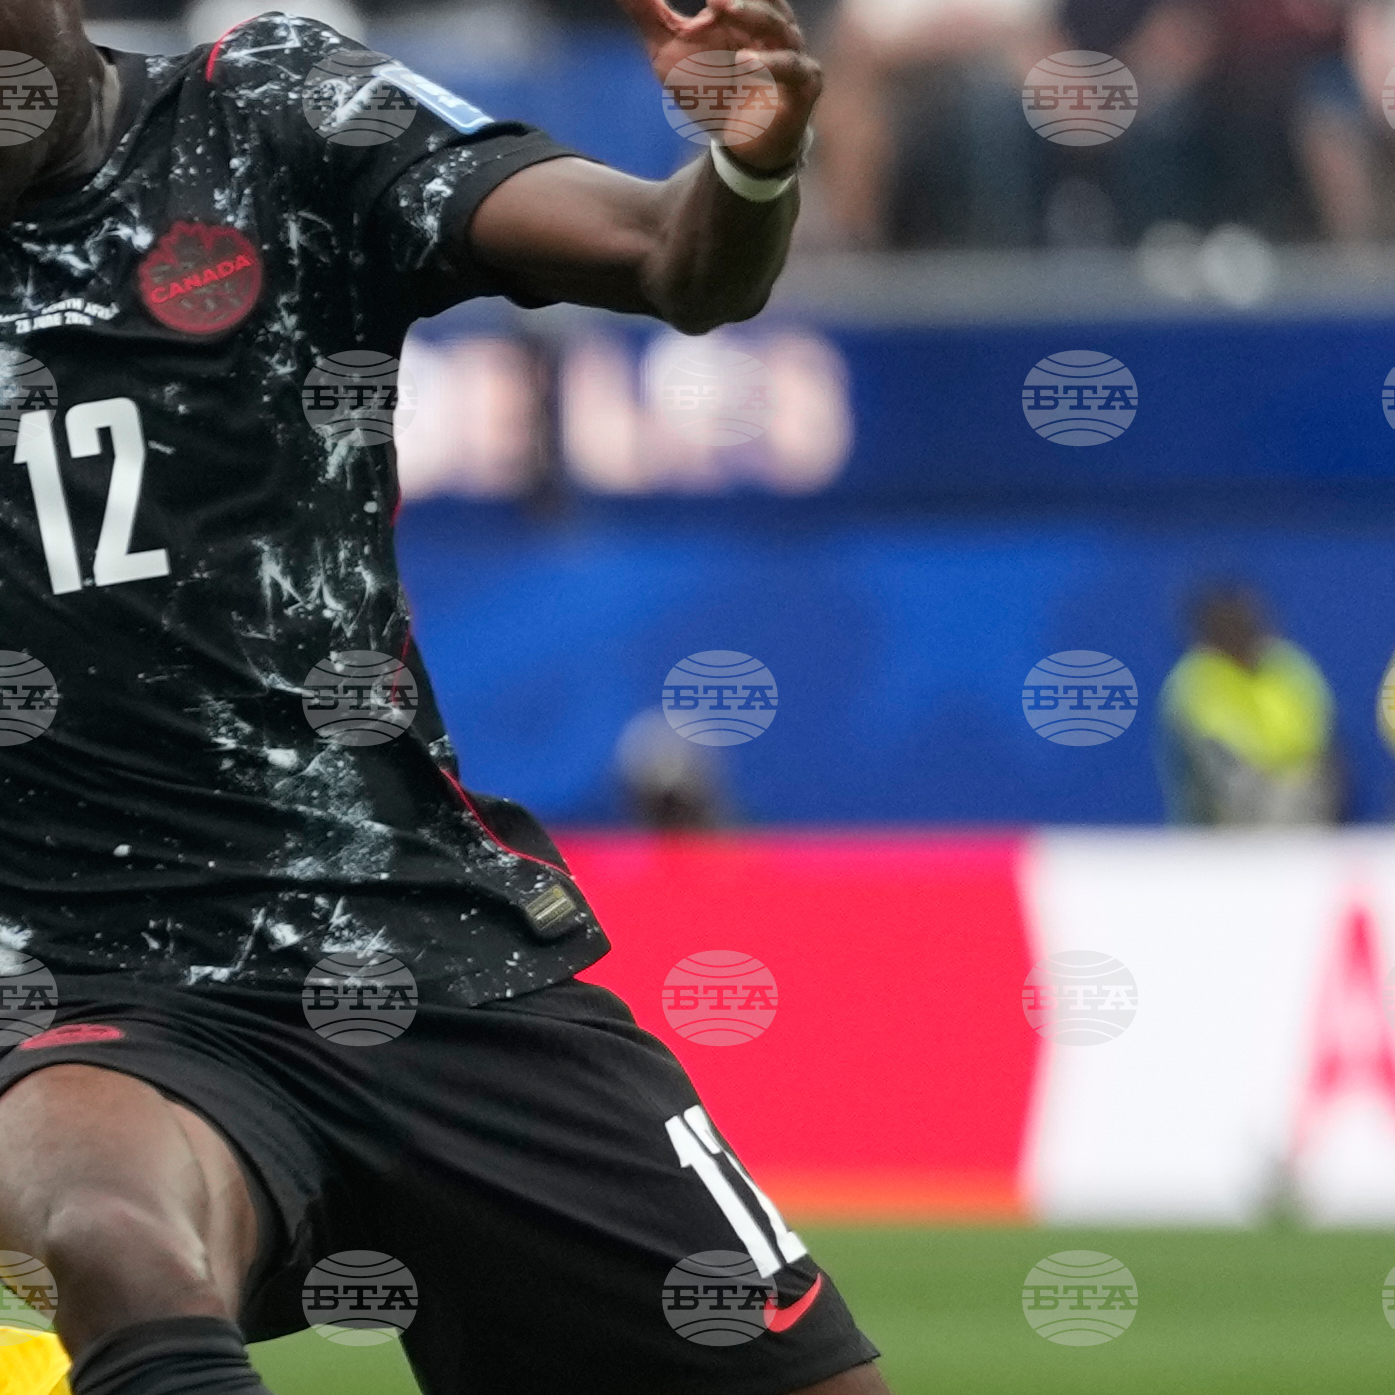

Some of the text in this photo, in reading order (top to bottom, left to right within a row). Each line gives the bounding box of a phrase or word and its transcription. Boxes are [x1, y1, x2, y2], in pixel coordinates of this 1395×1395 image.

[151, 254, 253, 304] CANADA
[14, 397, 171, 595] 12
[665, 1105, 807, 1279] 12
